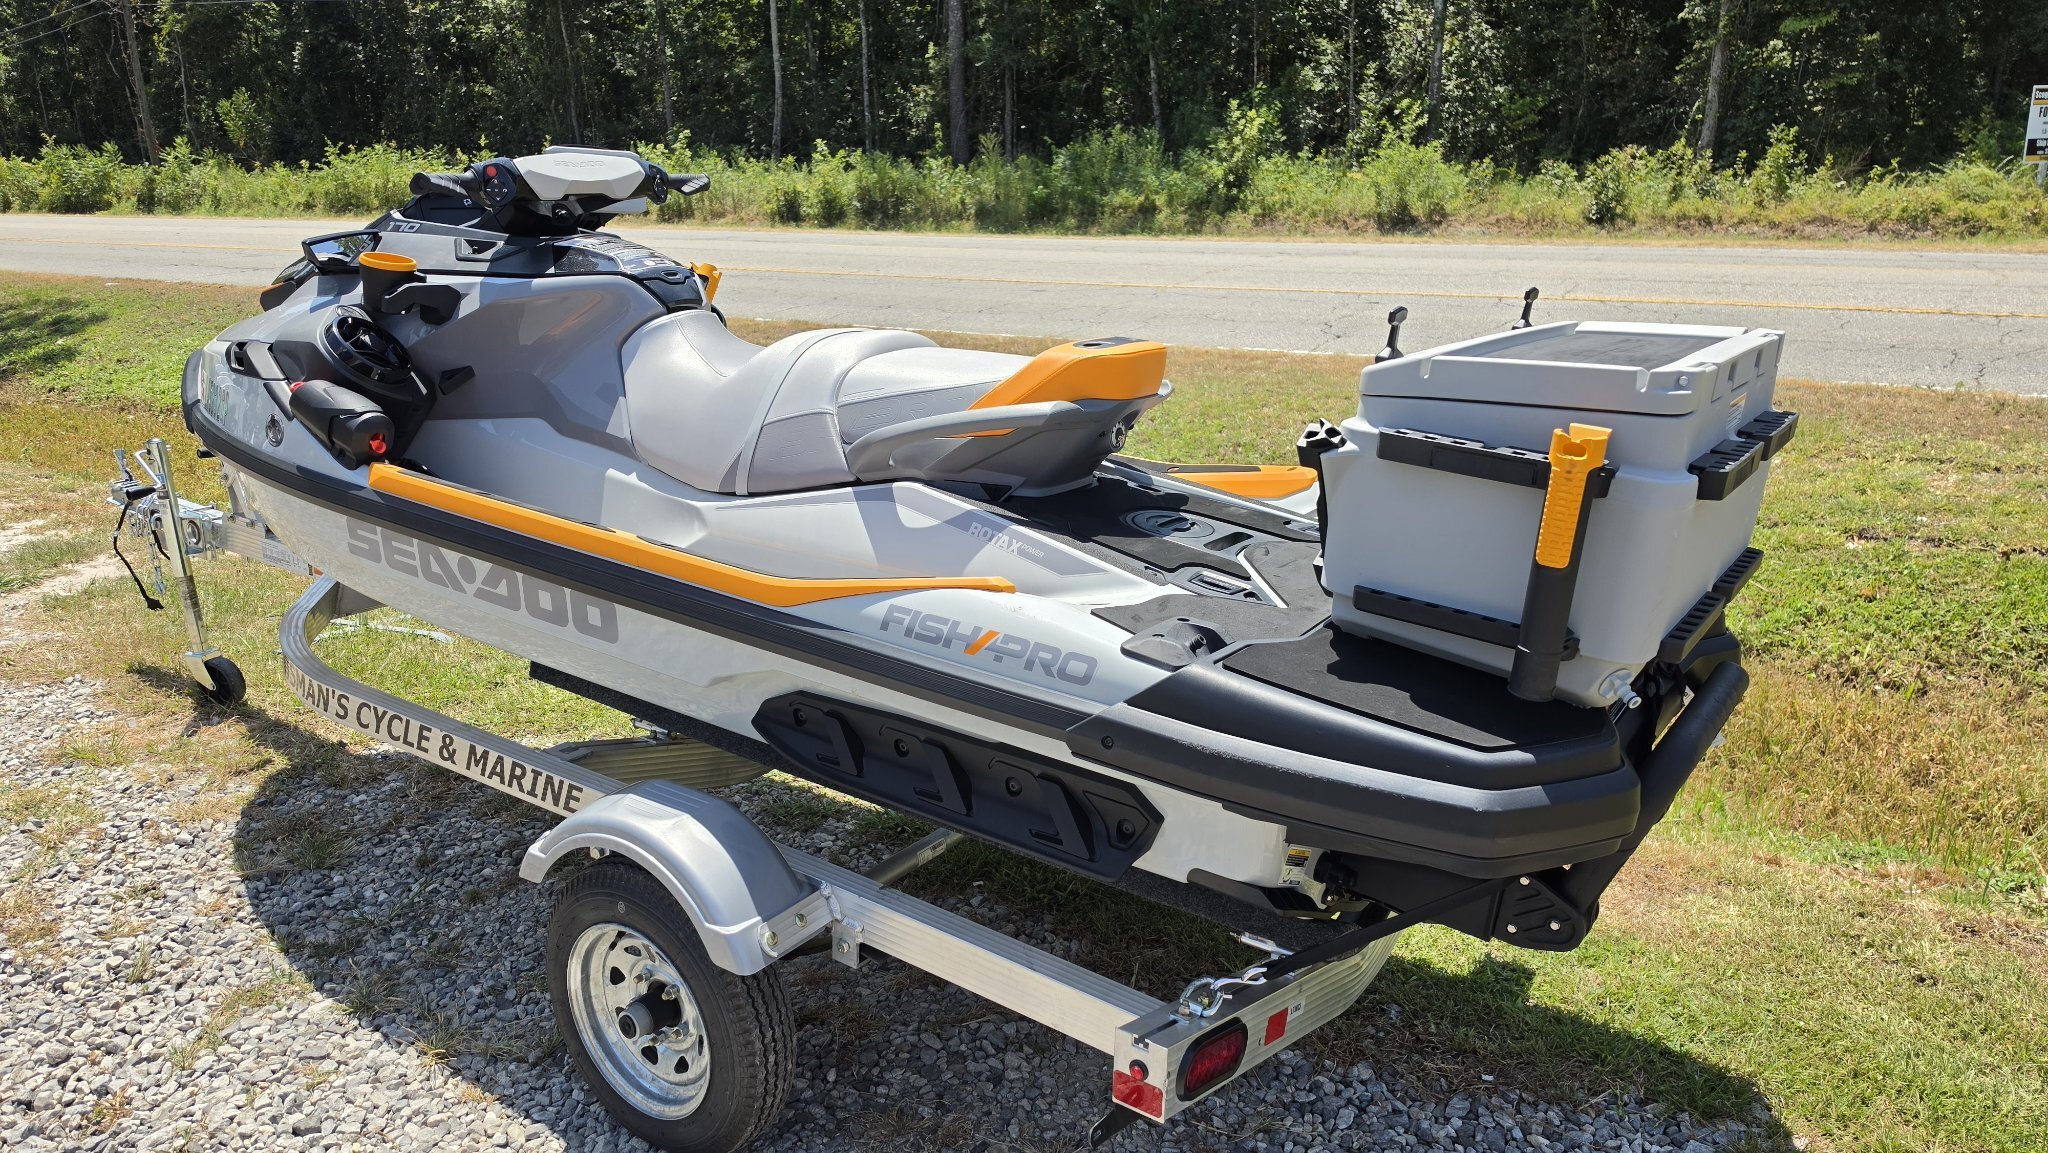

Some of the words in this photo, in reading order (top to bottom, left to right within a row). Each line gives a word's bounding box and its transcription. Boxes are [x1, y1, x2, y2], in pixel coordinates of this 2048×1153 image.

[387, 221, 421, 233] 170
[967, 521, 1022, 555] ROTAX
[1020, 543, 1045, 558] POWER
[356, 701, 433, 754] CYCLE
[438, 733, 458, 766] &
[465, 743, 584, 814] MARINE
